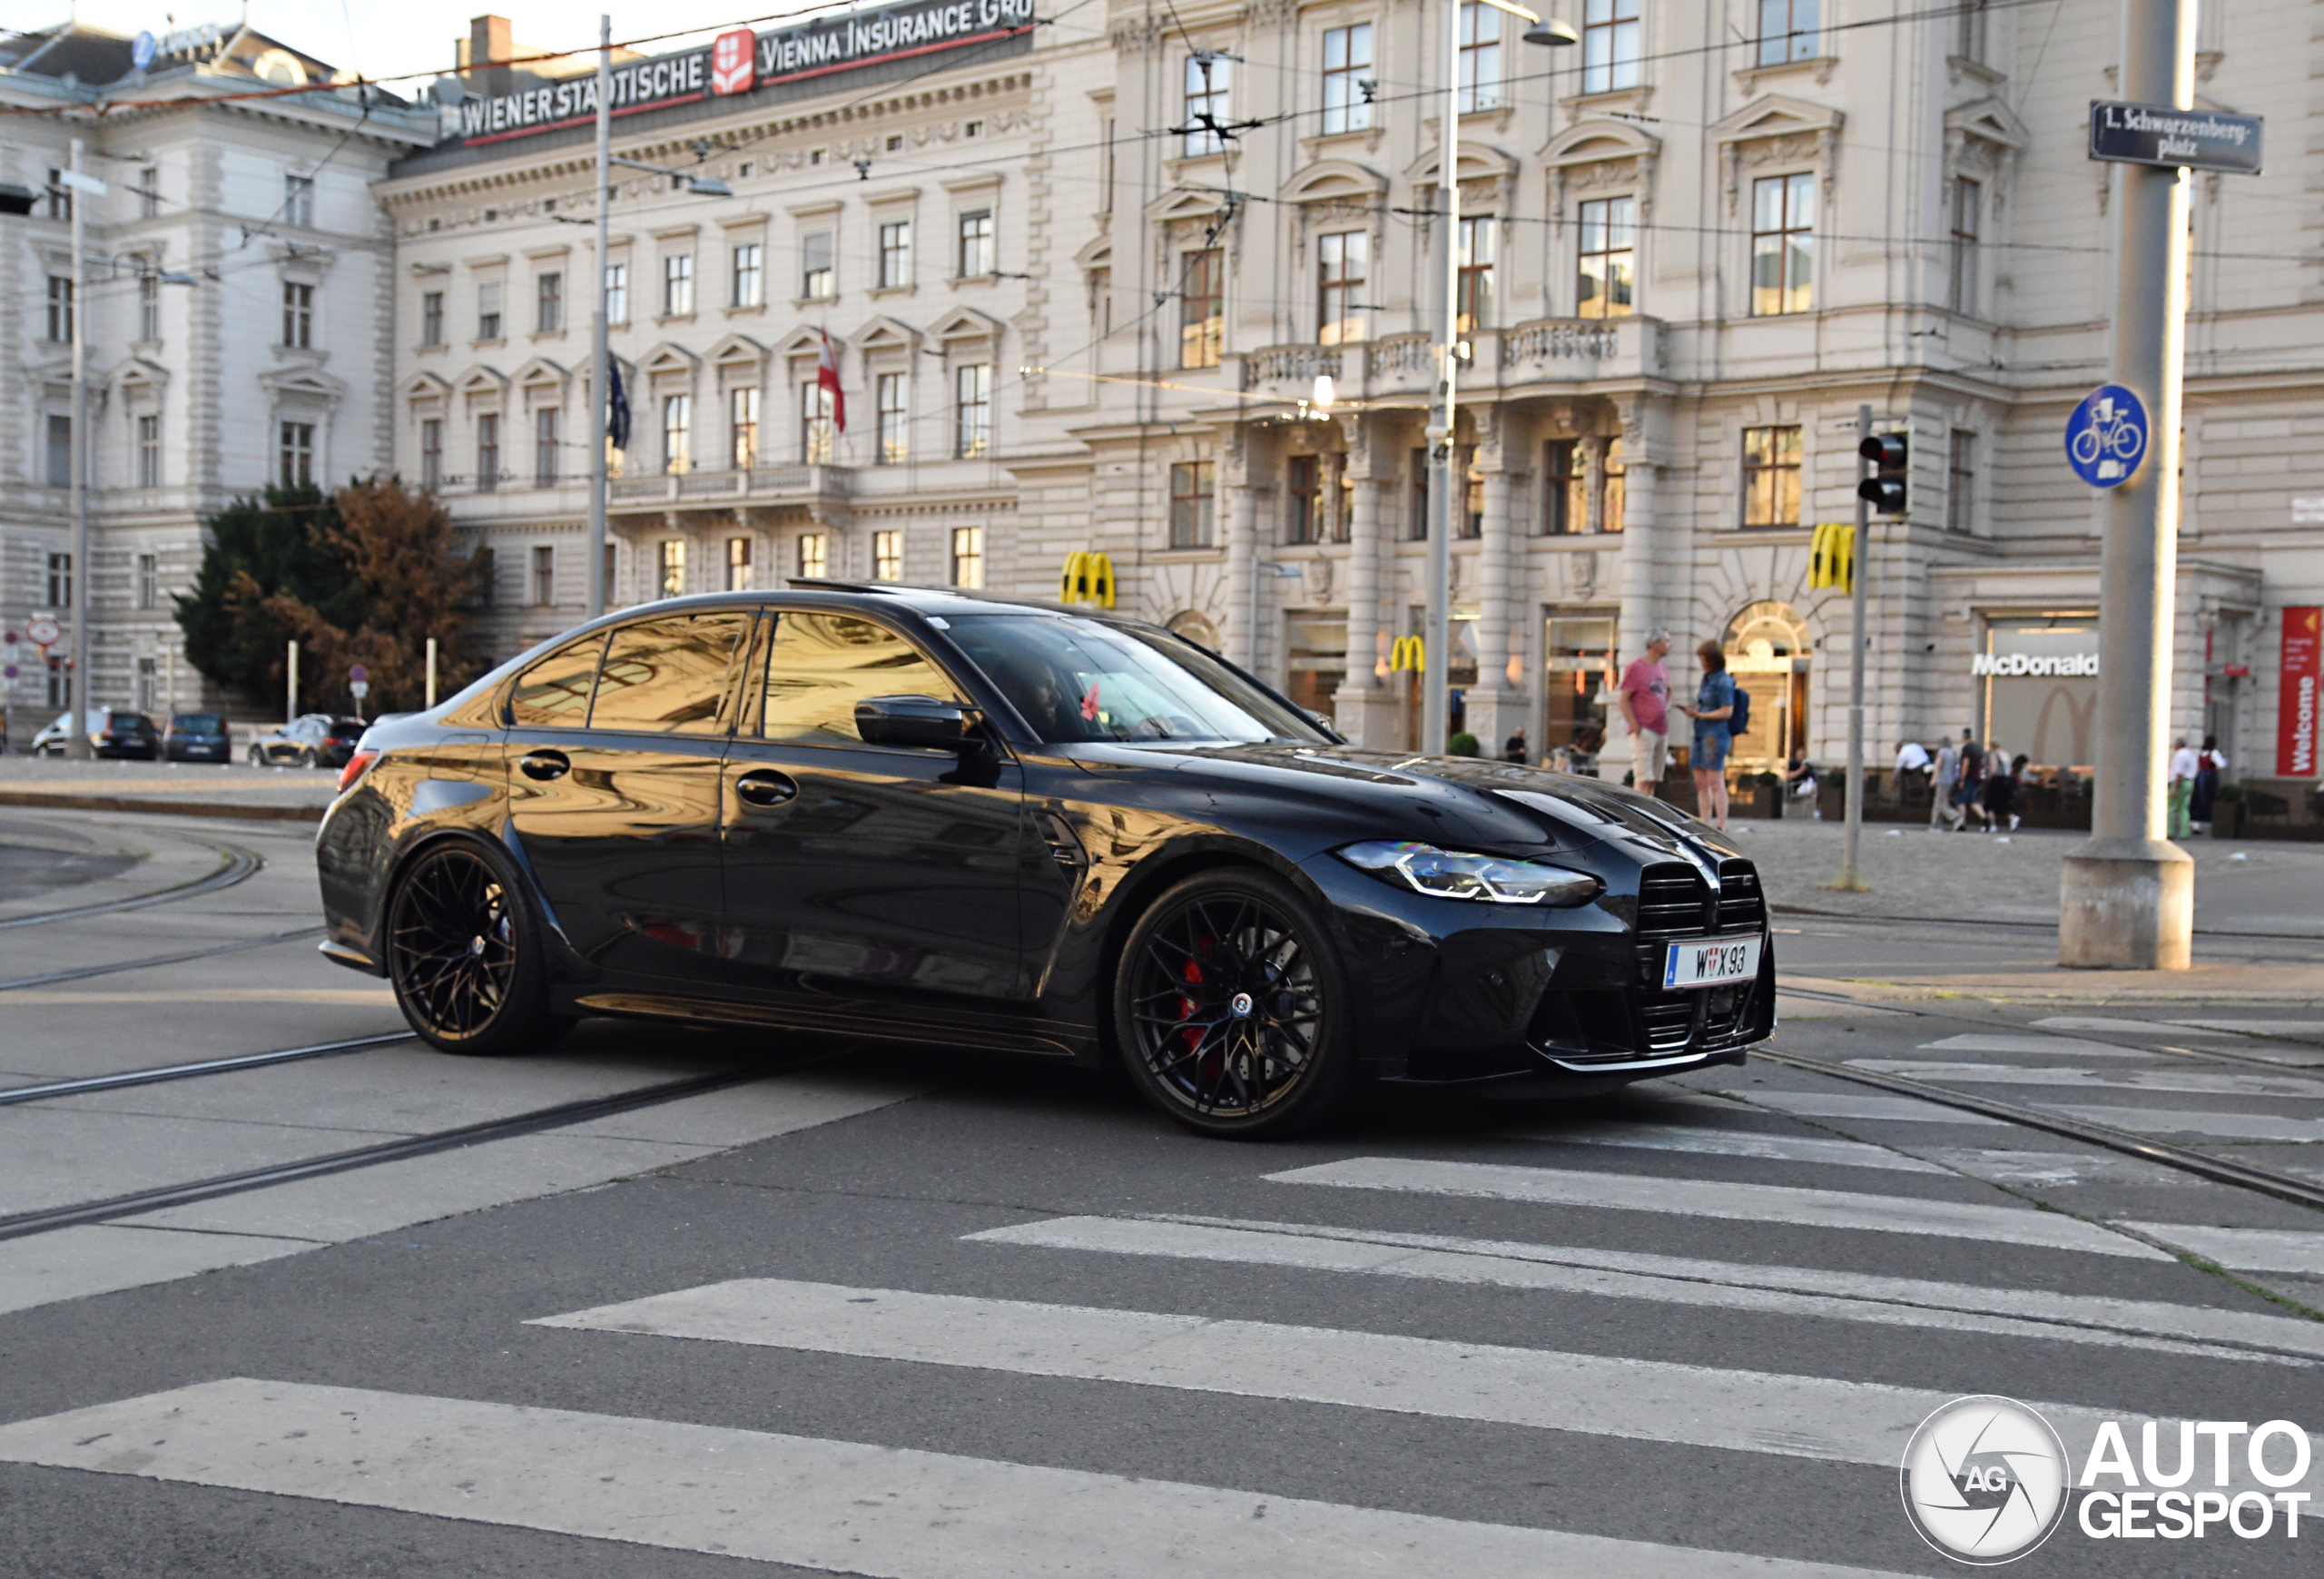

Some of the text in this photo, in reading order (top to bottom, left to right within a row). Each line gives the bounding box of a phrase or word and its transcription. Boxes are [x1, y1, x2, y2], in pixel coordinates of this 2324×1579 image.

[762, 32, 841, 73] VIENNA
[846, 5, 972, 56] INSURANCE
[463, 88, 553, 135] WIENER
[2105, 106, 2251, 145] 1. Schwarzenberg-
[2157, 134, 2199, 160] platz
[2292, 676, 2315, 772] Welcome
